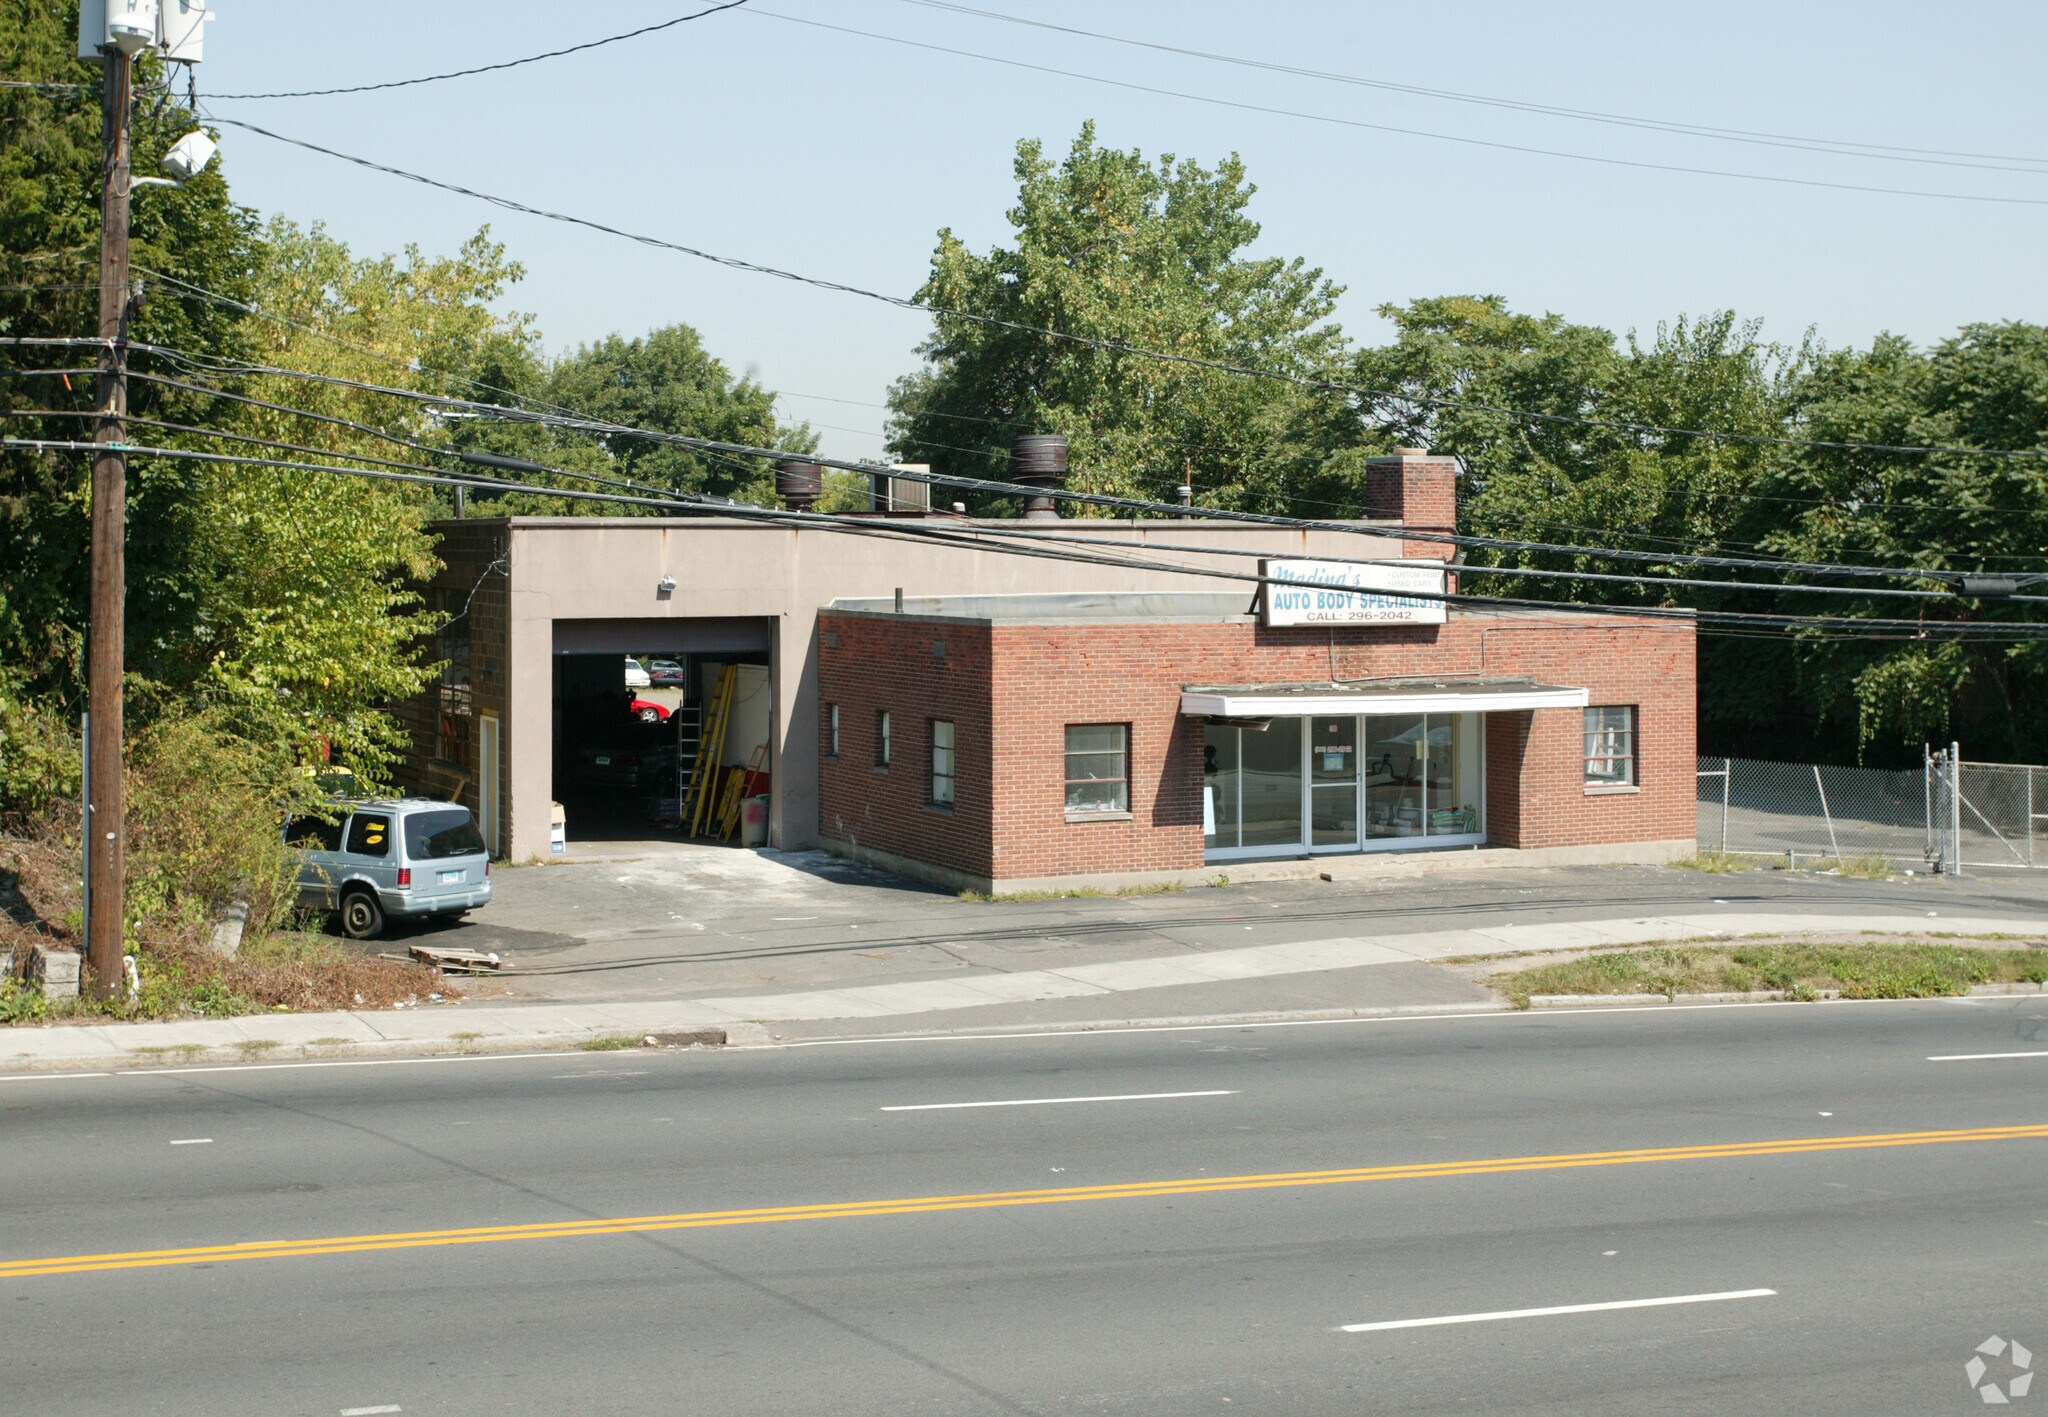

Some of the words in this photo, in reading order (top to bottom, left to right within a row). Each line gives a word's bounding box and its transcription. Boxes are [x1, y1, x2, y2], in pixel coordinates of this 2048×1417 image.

[1391, 571, 1420, 579] CUSTOM
[1274, 593, 1311, 610] AUTO
[1317, 592, 1354, 610] BODY
[1306, 612, 1342, 621] CALL:
[1348, 611, 1412, 621] 296-2042
